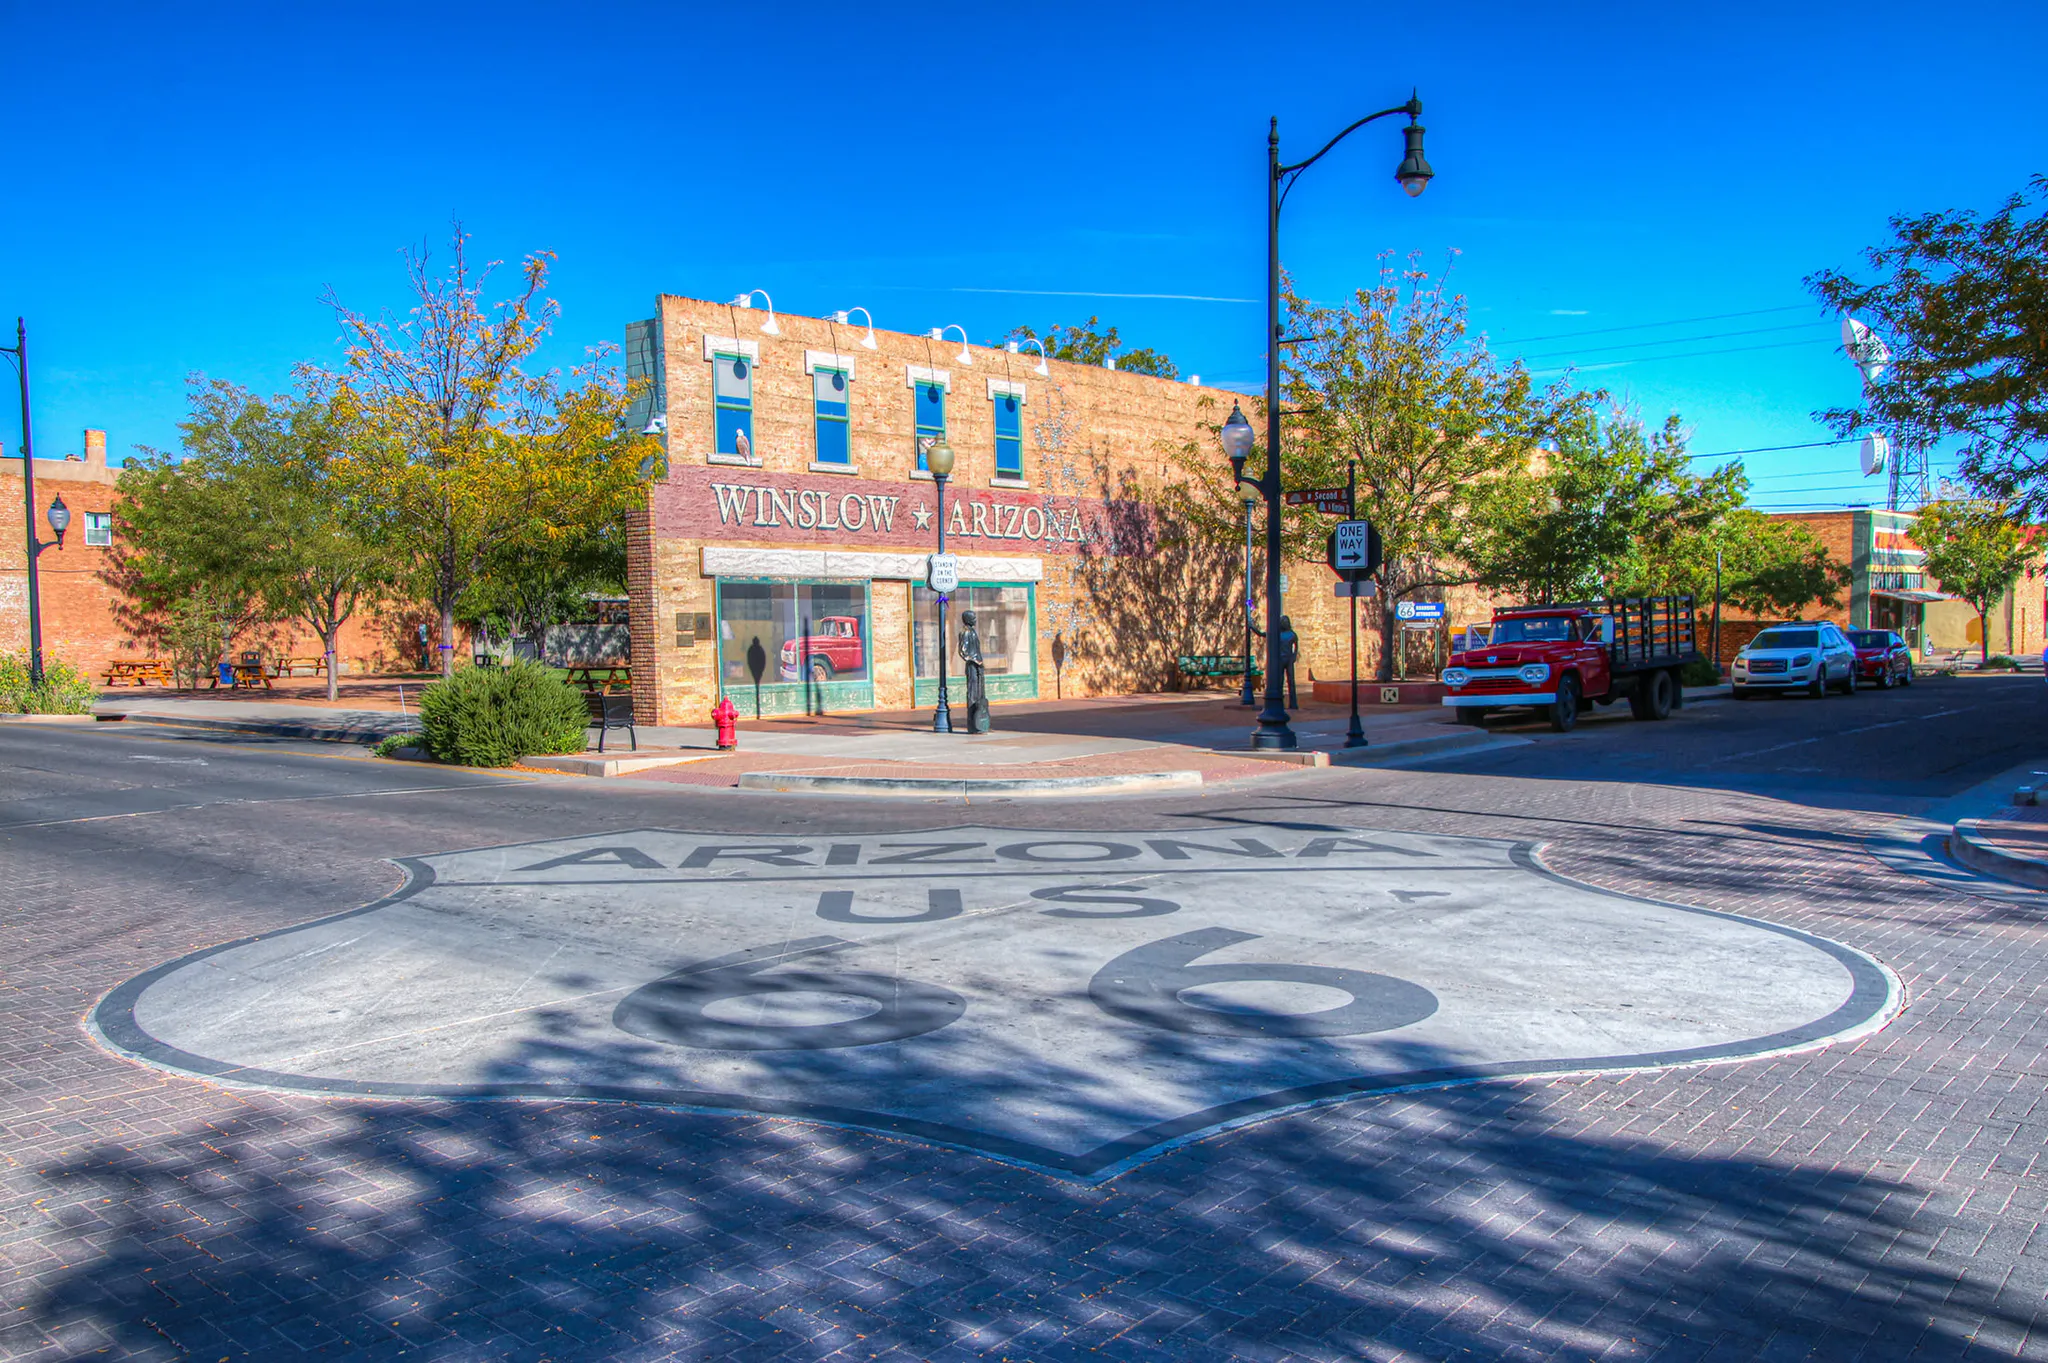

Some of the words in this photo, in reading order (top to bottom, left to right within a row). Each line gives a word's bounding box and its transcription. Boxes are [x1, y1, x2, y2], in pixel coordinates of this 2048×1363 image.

[1314, 489, 1338, 500] Second
[711, 483, 899, 532] WINSLOW
[946, 499, 1087, 543] ARIZONA
[1340, 526, 1363, 537] ONE
[1340, 538, 1363, 549] WAY
[1400, 607, 1412, 616] 66
[510, 838, 1441, 871] ARIZONA
[612, 926, 1439, 1050] 66
